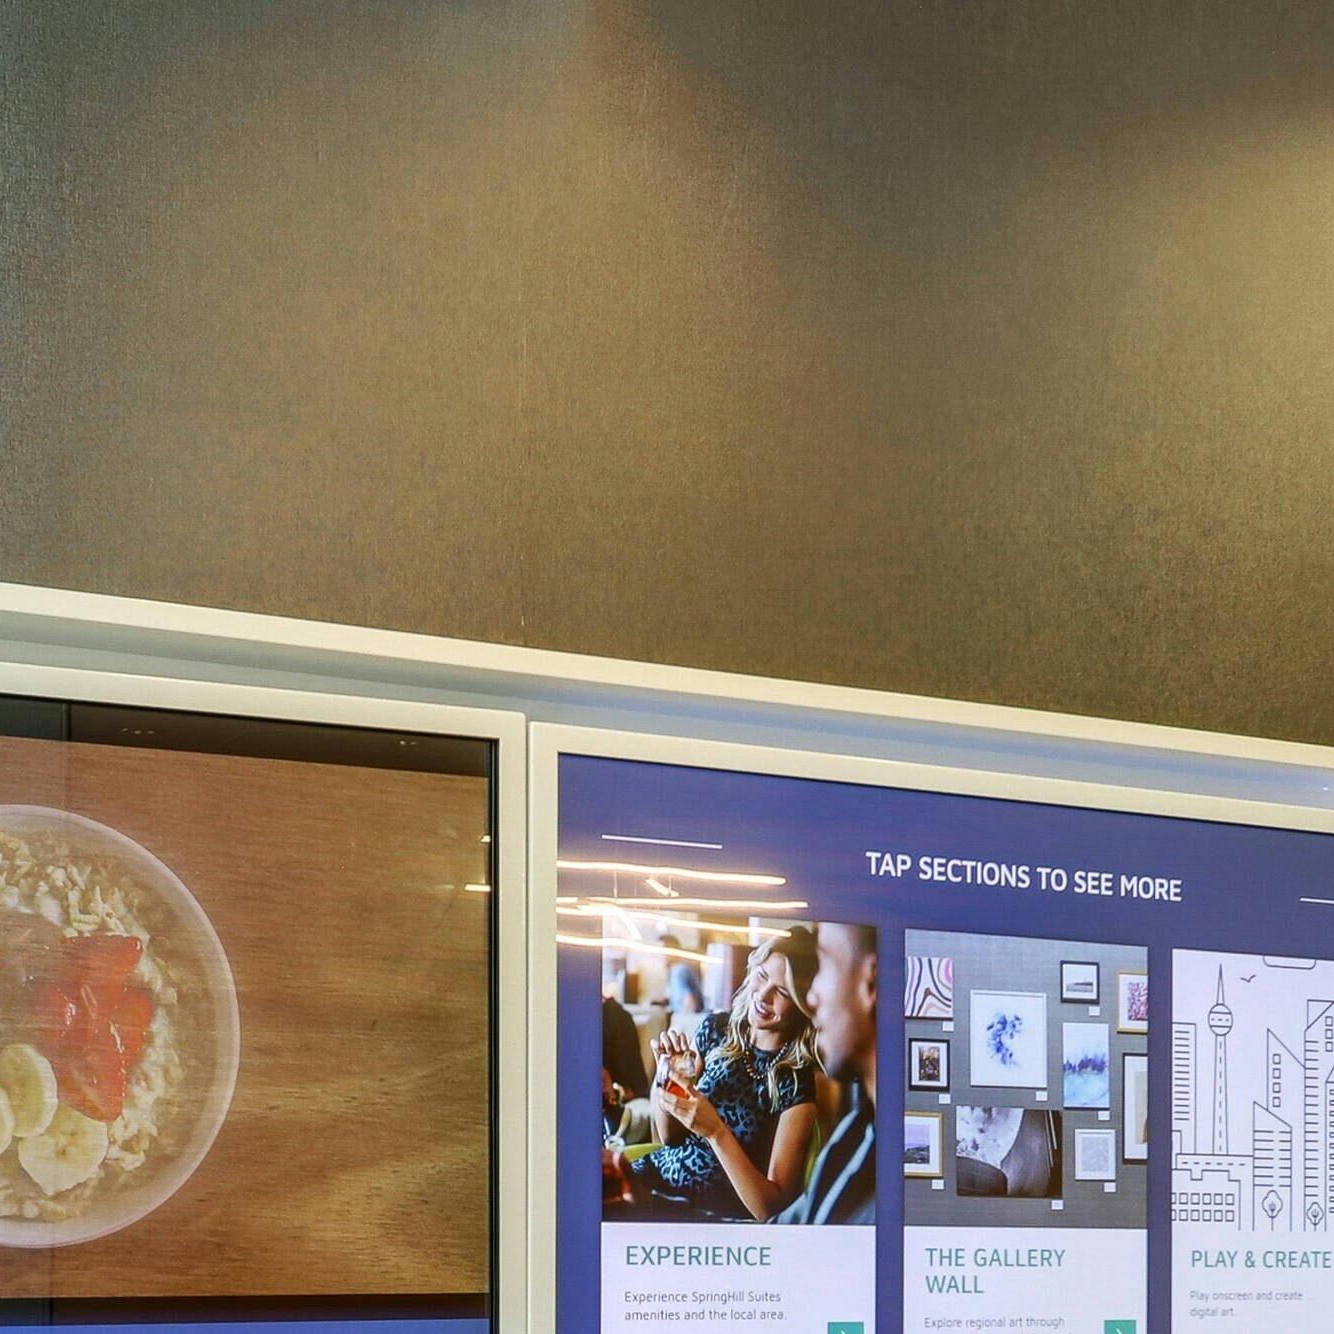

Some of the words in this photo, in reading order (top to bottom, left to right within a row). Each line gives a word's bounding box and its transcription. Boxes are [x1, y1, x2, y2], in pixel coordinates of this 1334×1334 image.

[865, 850, 912, 878] TAP
[918, 856, 1031, 889] SECTIONS
[1036, 867, 1067, 892] TO
[1073, 870, 1114, 896] SEE
[1120, 874, 1183, 902] MORE
[626, 1245, 772, 1267] EXPERIENCE
[925, 1247, 966, 1268] THE
[973, 1248, 1066, 1268] GALLERY
[1191, 1250, 1238, 1269] PLAY
[1244, 1250, 1256, 1269] &
[1262, 1250, 1332, 1269] CREATE
[925, 1275, 985, 1295] WALL
[624, 1291, 688, 1305] Experience
[691, 1290, 745, 1305] SpringHill
[748, 1291, 781, 1303] Suites
[1189, 1290, 1209, 1303] Play
[1211, 1291, 1254, 1301] onscreen
[1255, 1290, 1273, 1301] and
[1274, 1290, 1303, 1301] create
[625, 1309, 680, 1321] amenities
[684, 1309, 705, 1321] and
[709, 1309, 727, 1321] the
[730, 1309, 756, 1321] local
[1189, 1308, 1218, 1320] digital
[924, 1317, 963, 1331] Explore
[966, 1317, 1006, 1331] regional
[1009, 1317, 1023, 1328] art
[1026, 1317, 1065, 1330] through
